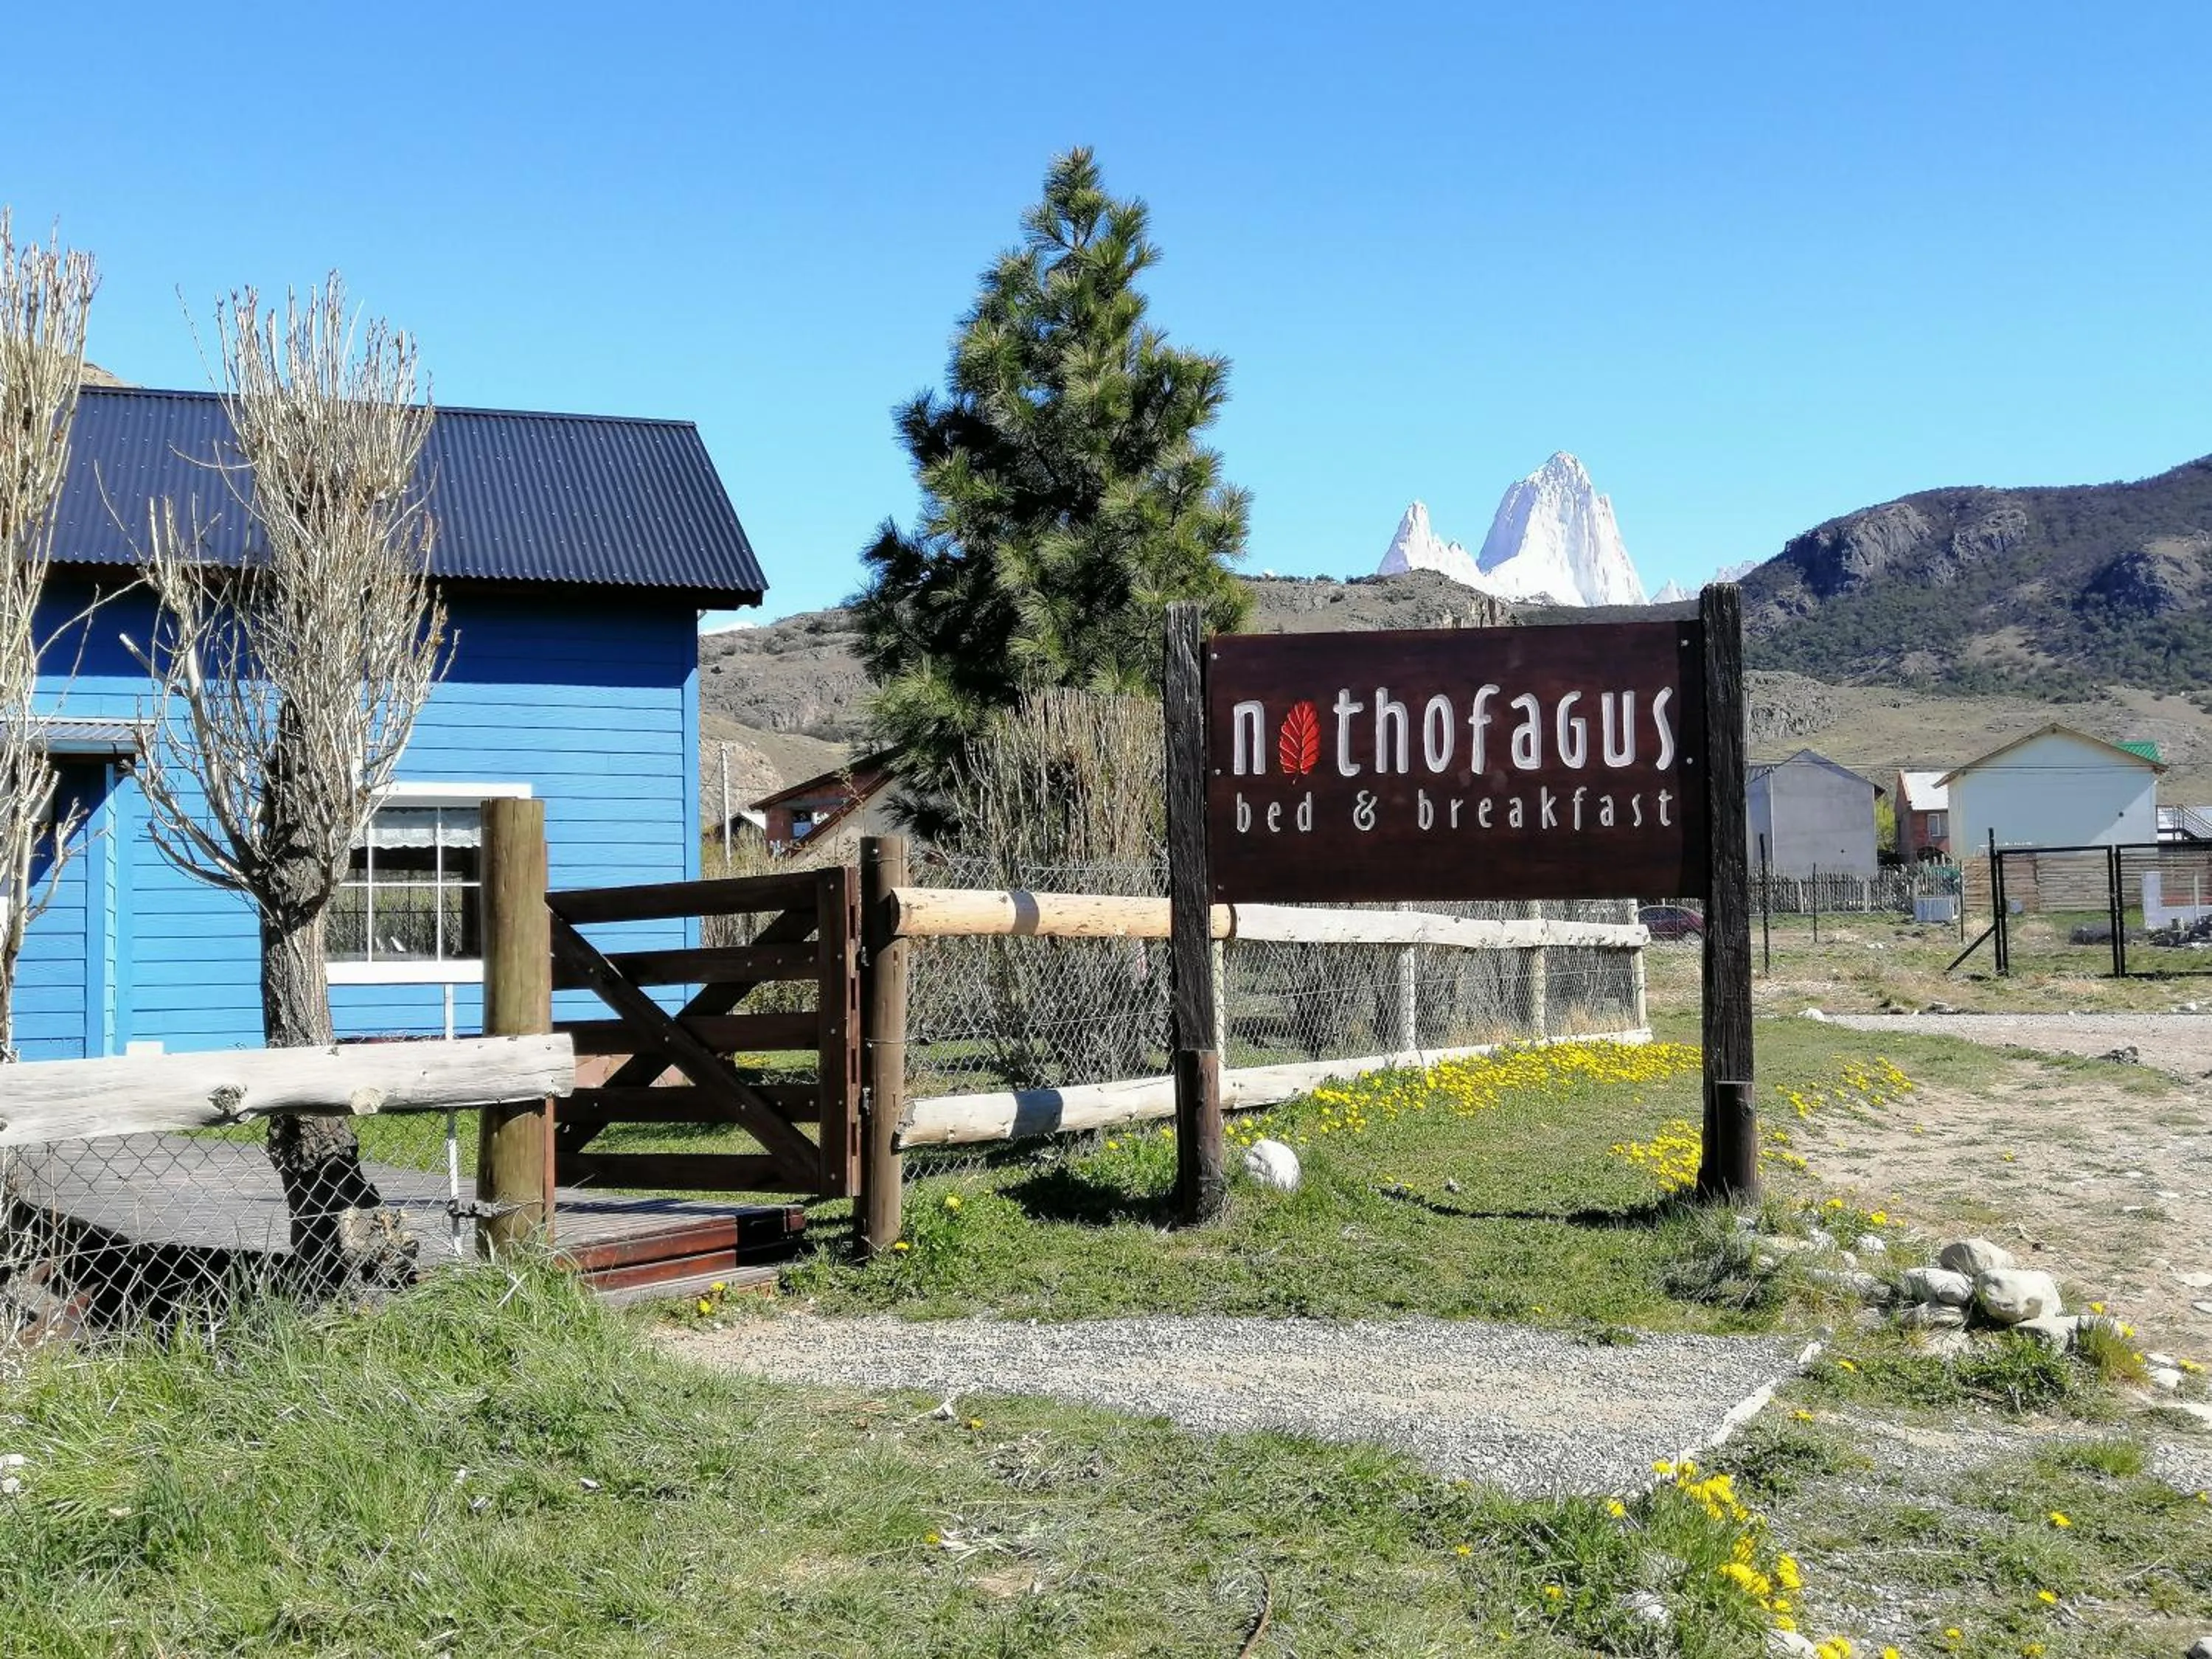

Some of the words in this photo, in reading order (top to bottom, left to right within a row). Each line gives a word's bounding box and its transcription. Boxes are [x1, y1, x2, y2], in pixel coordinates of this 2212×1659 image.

[1236, 790, 1313, 834] bed
[1352, 789, 1379, 832] &
[1417, 785, 1674, 832] breakfast
